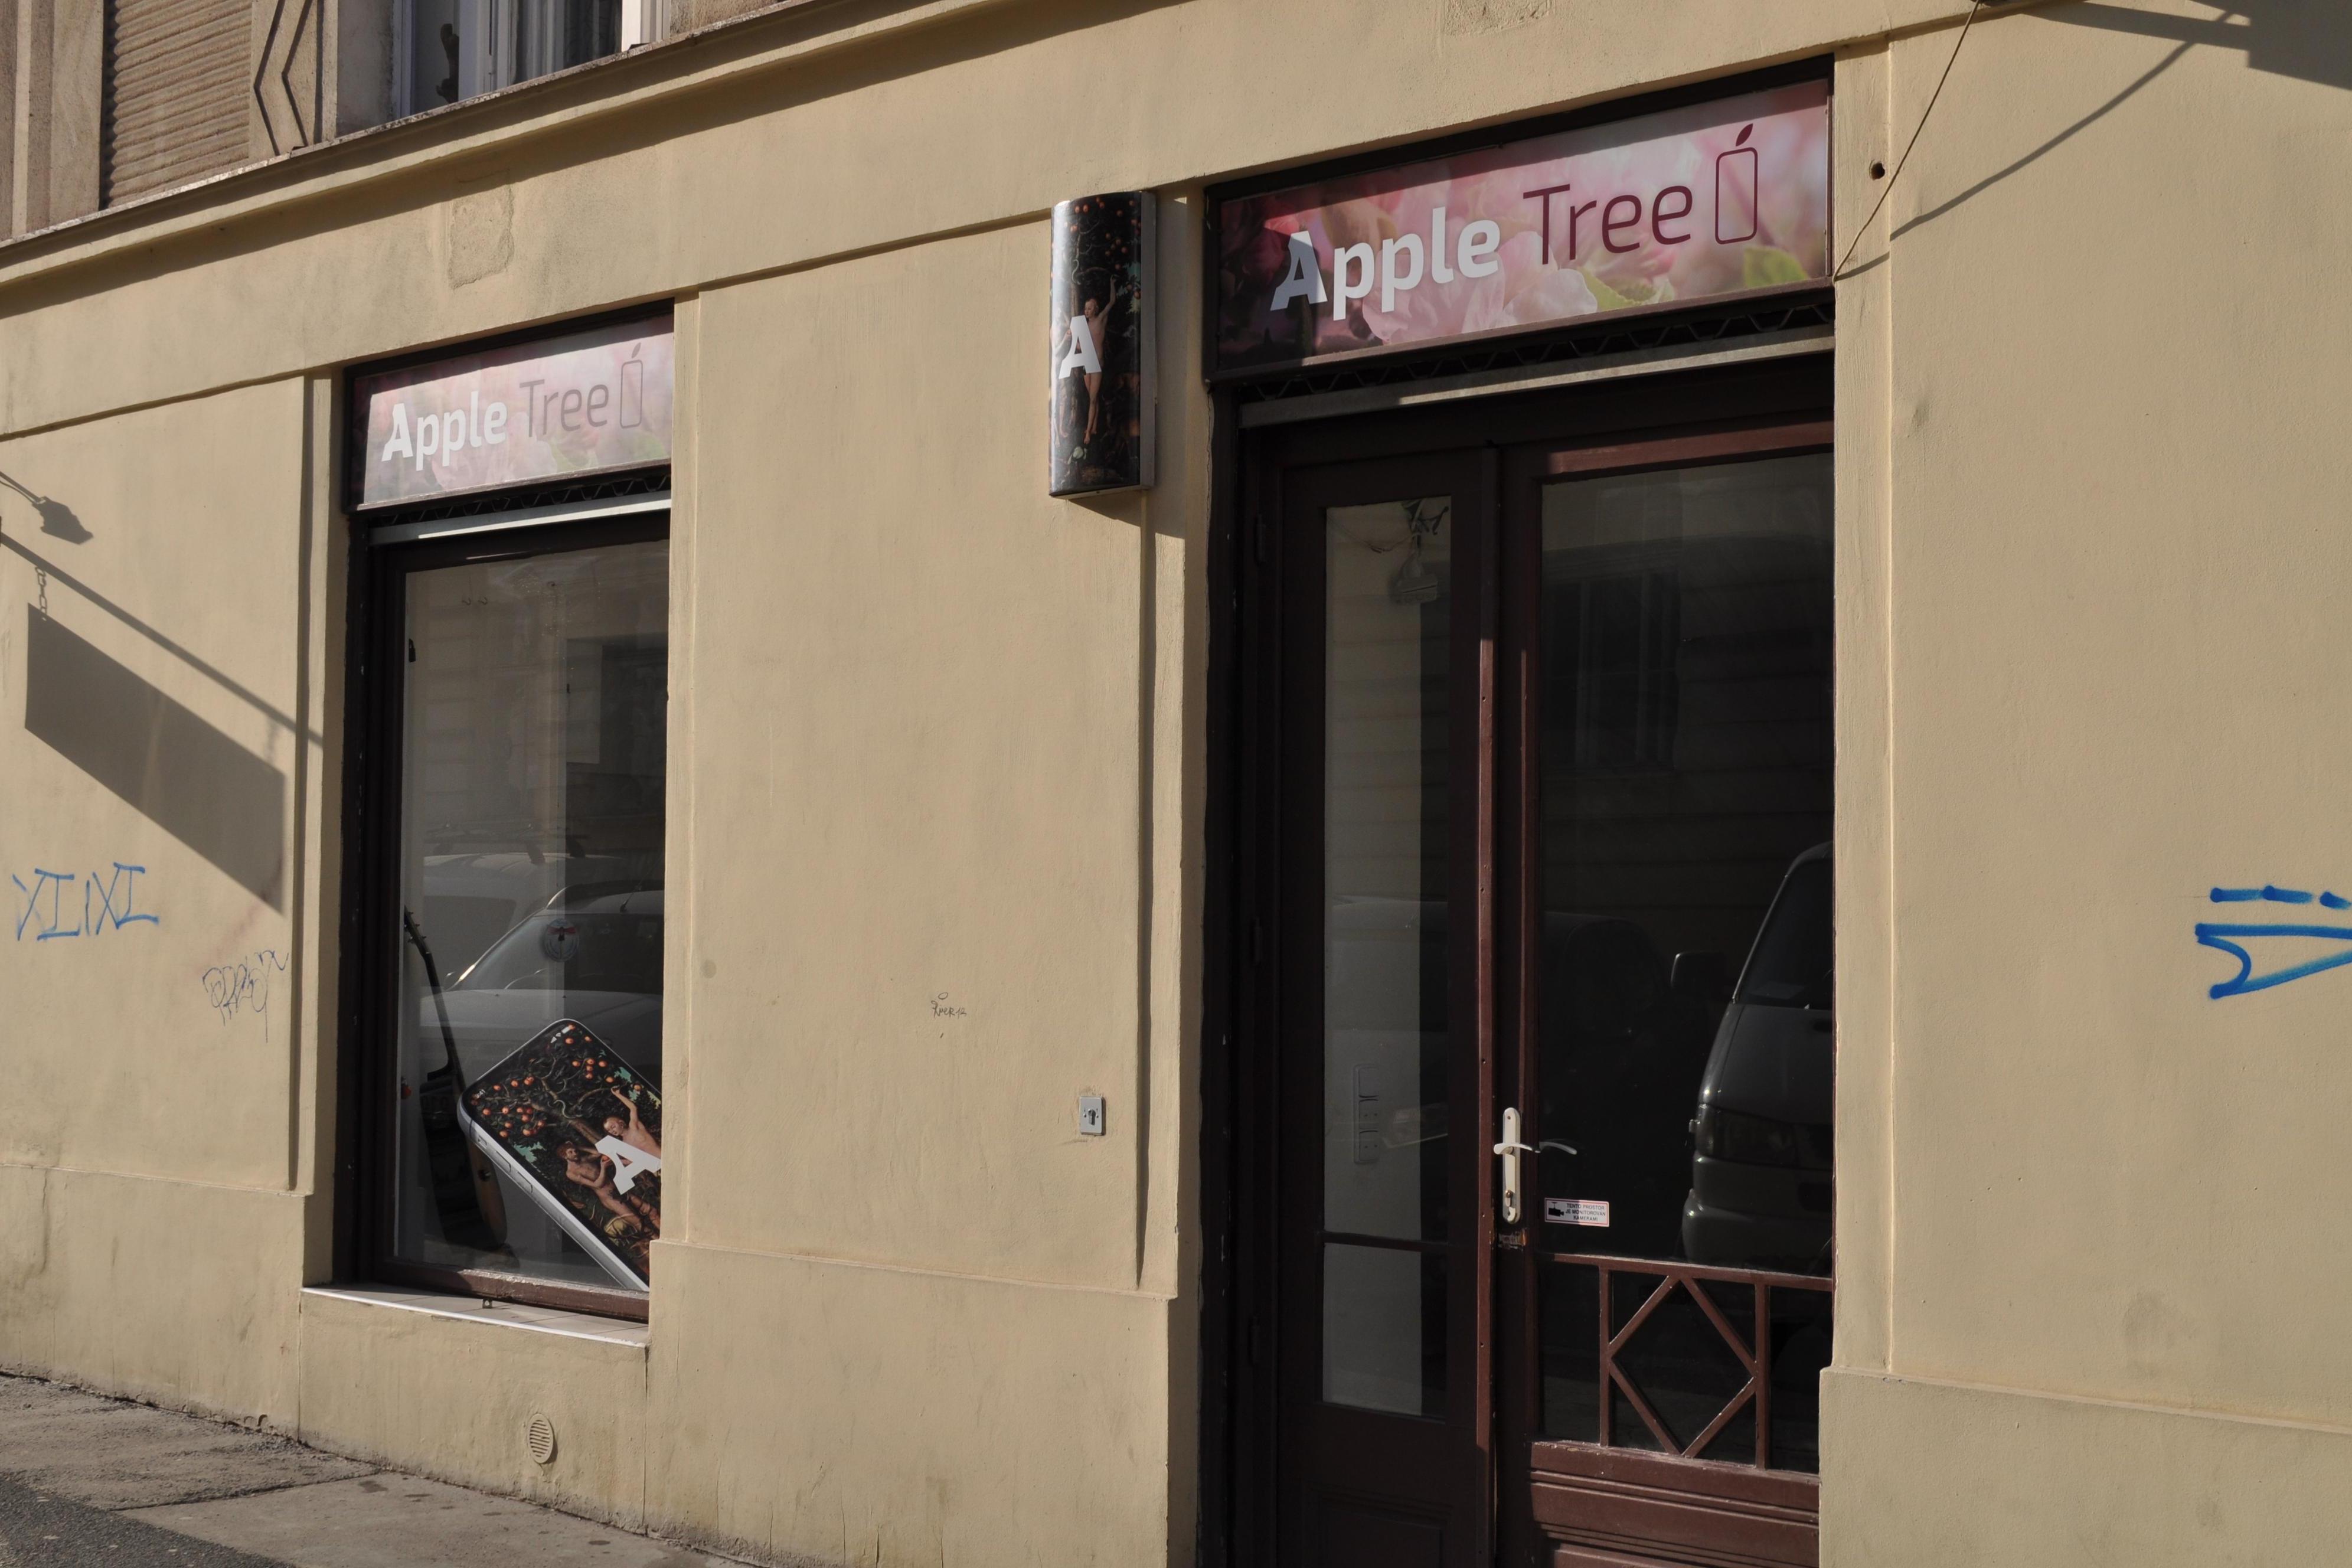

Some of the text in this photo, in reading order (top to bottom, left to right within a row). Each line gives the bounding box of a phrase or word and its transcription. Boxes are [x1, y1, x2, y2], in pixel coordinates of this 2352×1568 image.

[1270, 184, 1693, 321] Apple Tree
[1058, 315, 1102, 380] A
[381, 378, 609, 472] Apple Tree
[594, 1135, 661, 1195] A
